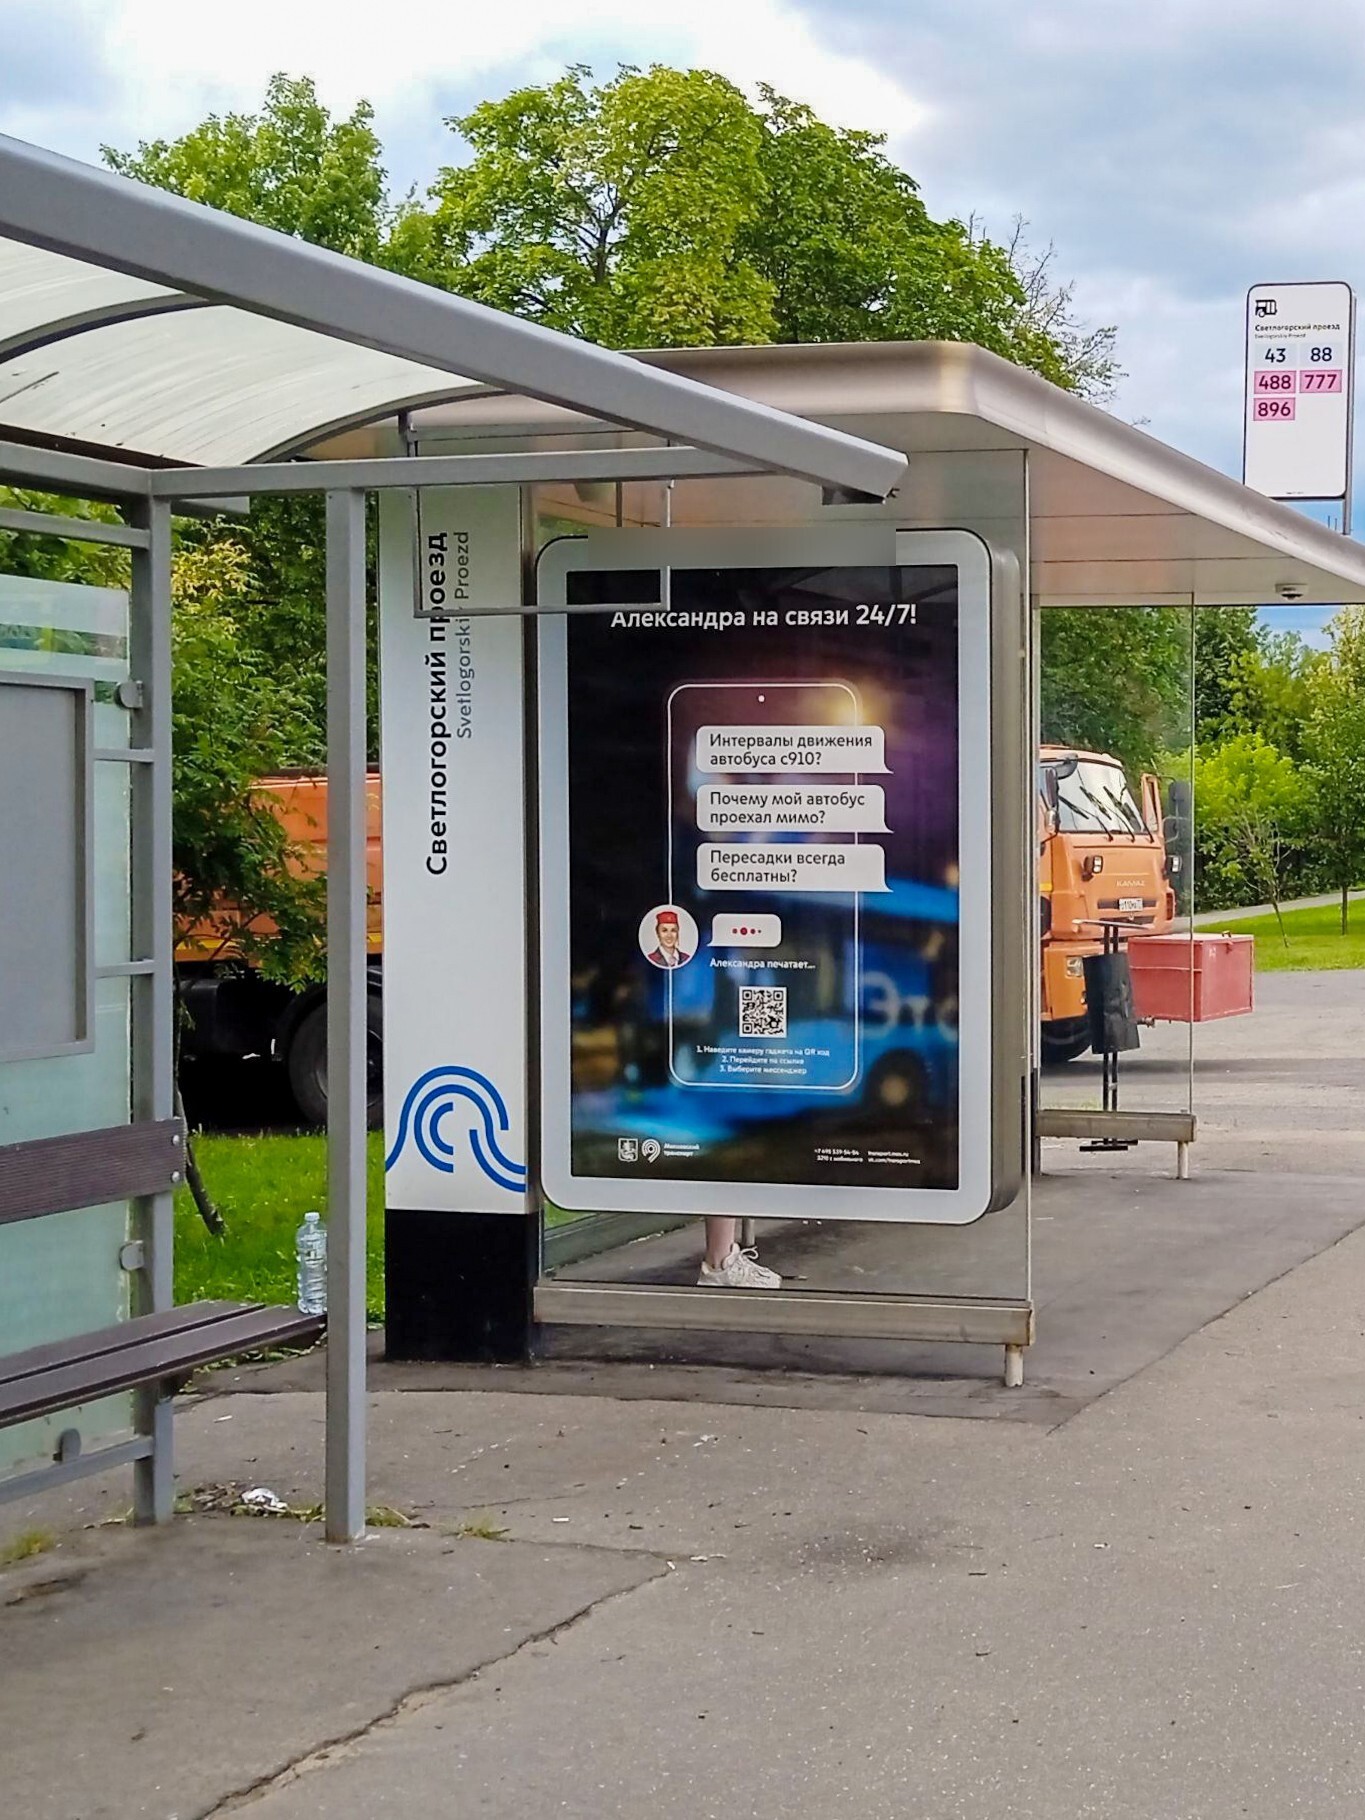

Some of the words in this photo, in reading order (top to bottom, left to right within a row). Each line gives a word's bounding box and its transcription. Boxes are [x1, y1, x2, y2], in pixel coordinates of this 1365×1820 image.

[1264, 347, 1286, 363] 43
[1310, 346, 1333, 362] 88
[1258, 374, 1291, 390] 488
[1304, 373, 1337, 389] 777
[1257, 401, 1291, 417] 896
[453, 531, 469, 599] Proezd
[610, 611, 746, 631] Александра
[753, 609, 779, 626] на
[785, 609, 849, 626] связи
[855, 604, 917, 626] 24/7!
[455, 607, 474, 739] Svetlogorski
[710, 733, 794, 749] Интервалы
[796, 735, 872, 748] движения
[425, 651, 452, 875] Светлогорский
[710, 751, 777, 769] автобуса
[780, 752, 822, 766] с910?
[710, 792, 768, 808] Почему
[772, 791, 802, 805] мой
[806, 792, 865, 808] автобус
[710, 812, 772, 827] проехал
[776, 810, 826, 824] мимо?
[710, 850, 792, 867] Пересадки
[797, 853, 845, 867] всегда
[711, 869, 797, 883] бесплатны?
[709, 957, 765, 969] Александра
